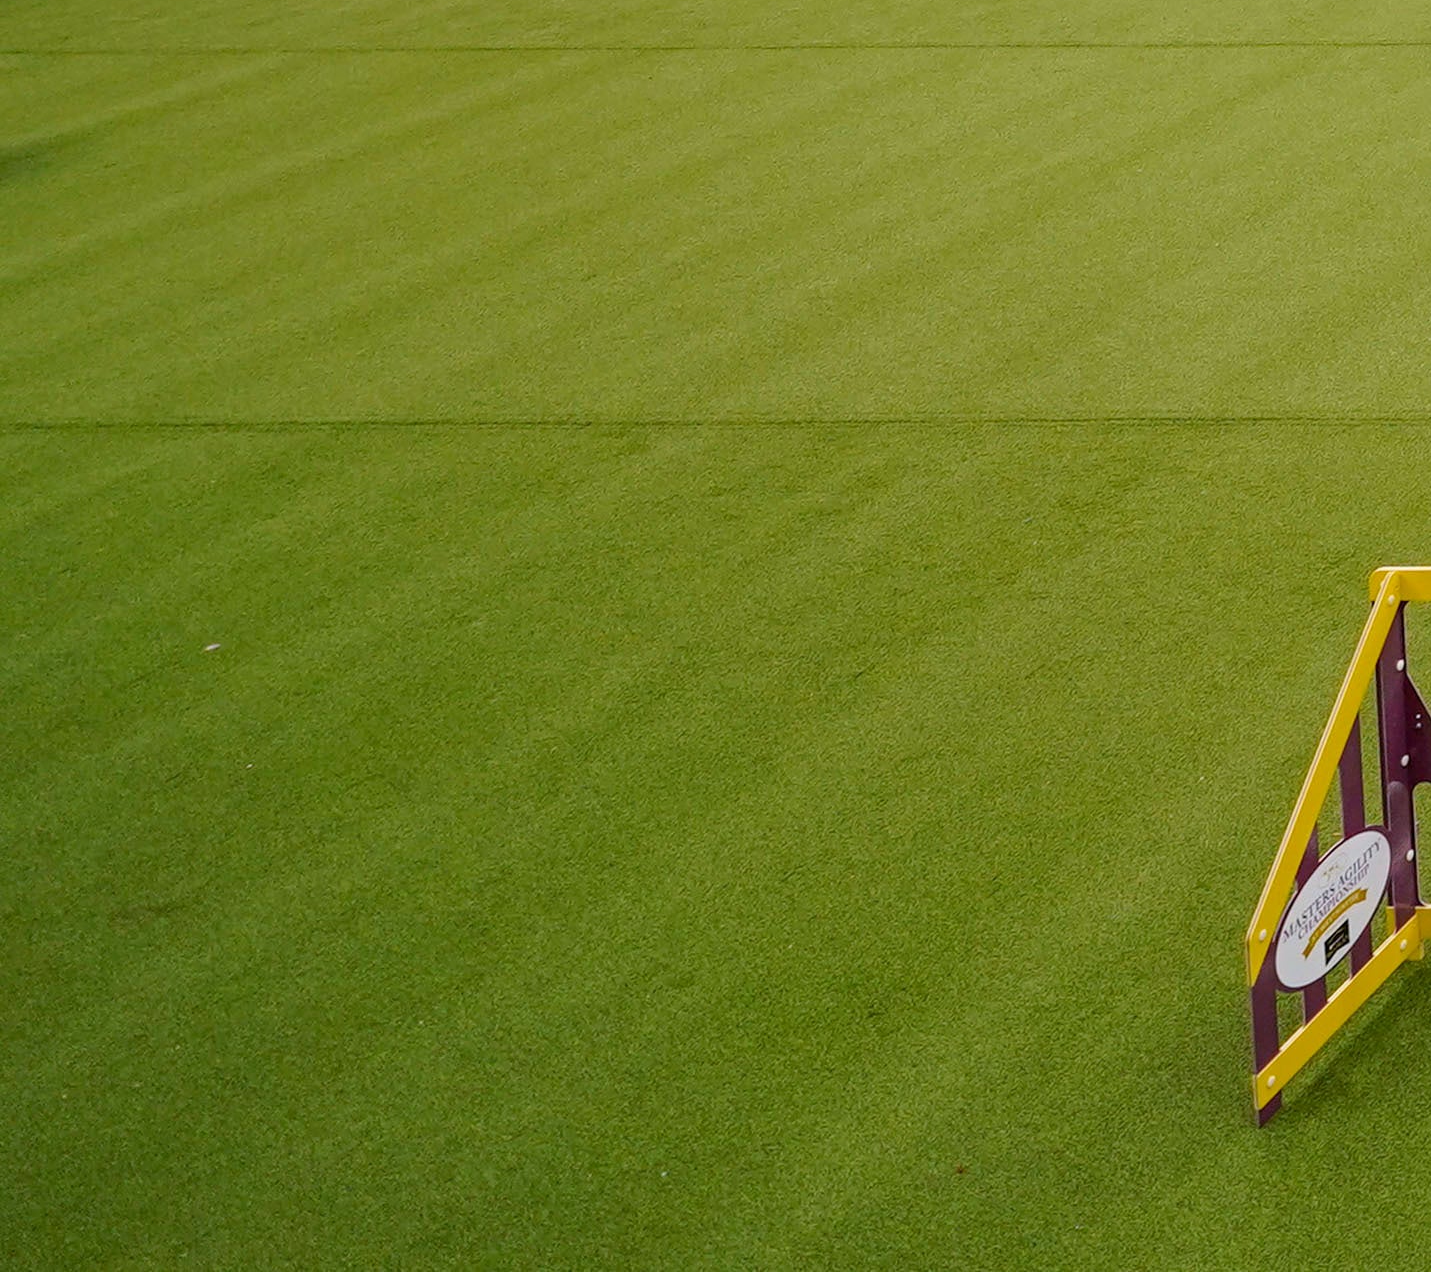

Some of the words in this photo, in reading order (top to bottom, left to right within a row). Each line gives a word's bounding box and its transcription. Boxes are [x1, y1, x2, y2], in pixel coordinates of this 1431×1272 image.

[1283, 883, 1336, 942] MASTERS
[1338, 839, 1381, 887] AGILITY
[1298, 864, 1370, 940] CHAMPIONSHIP
